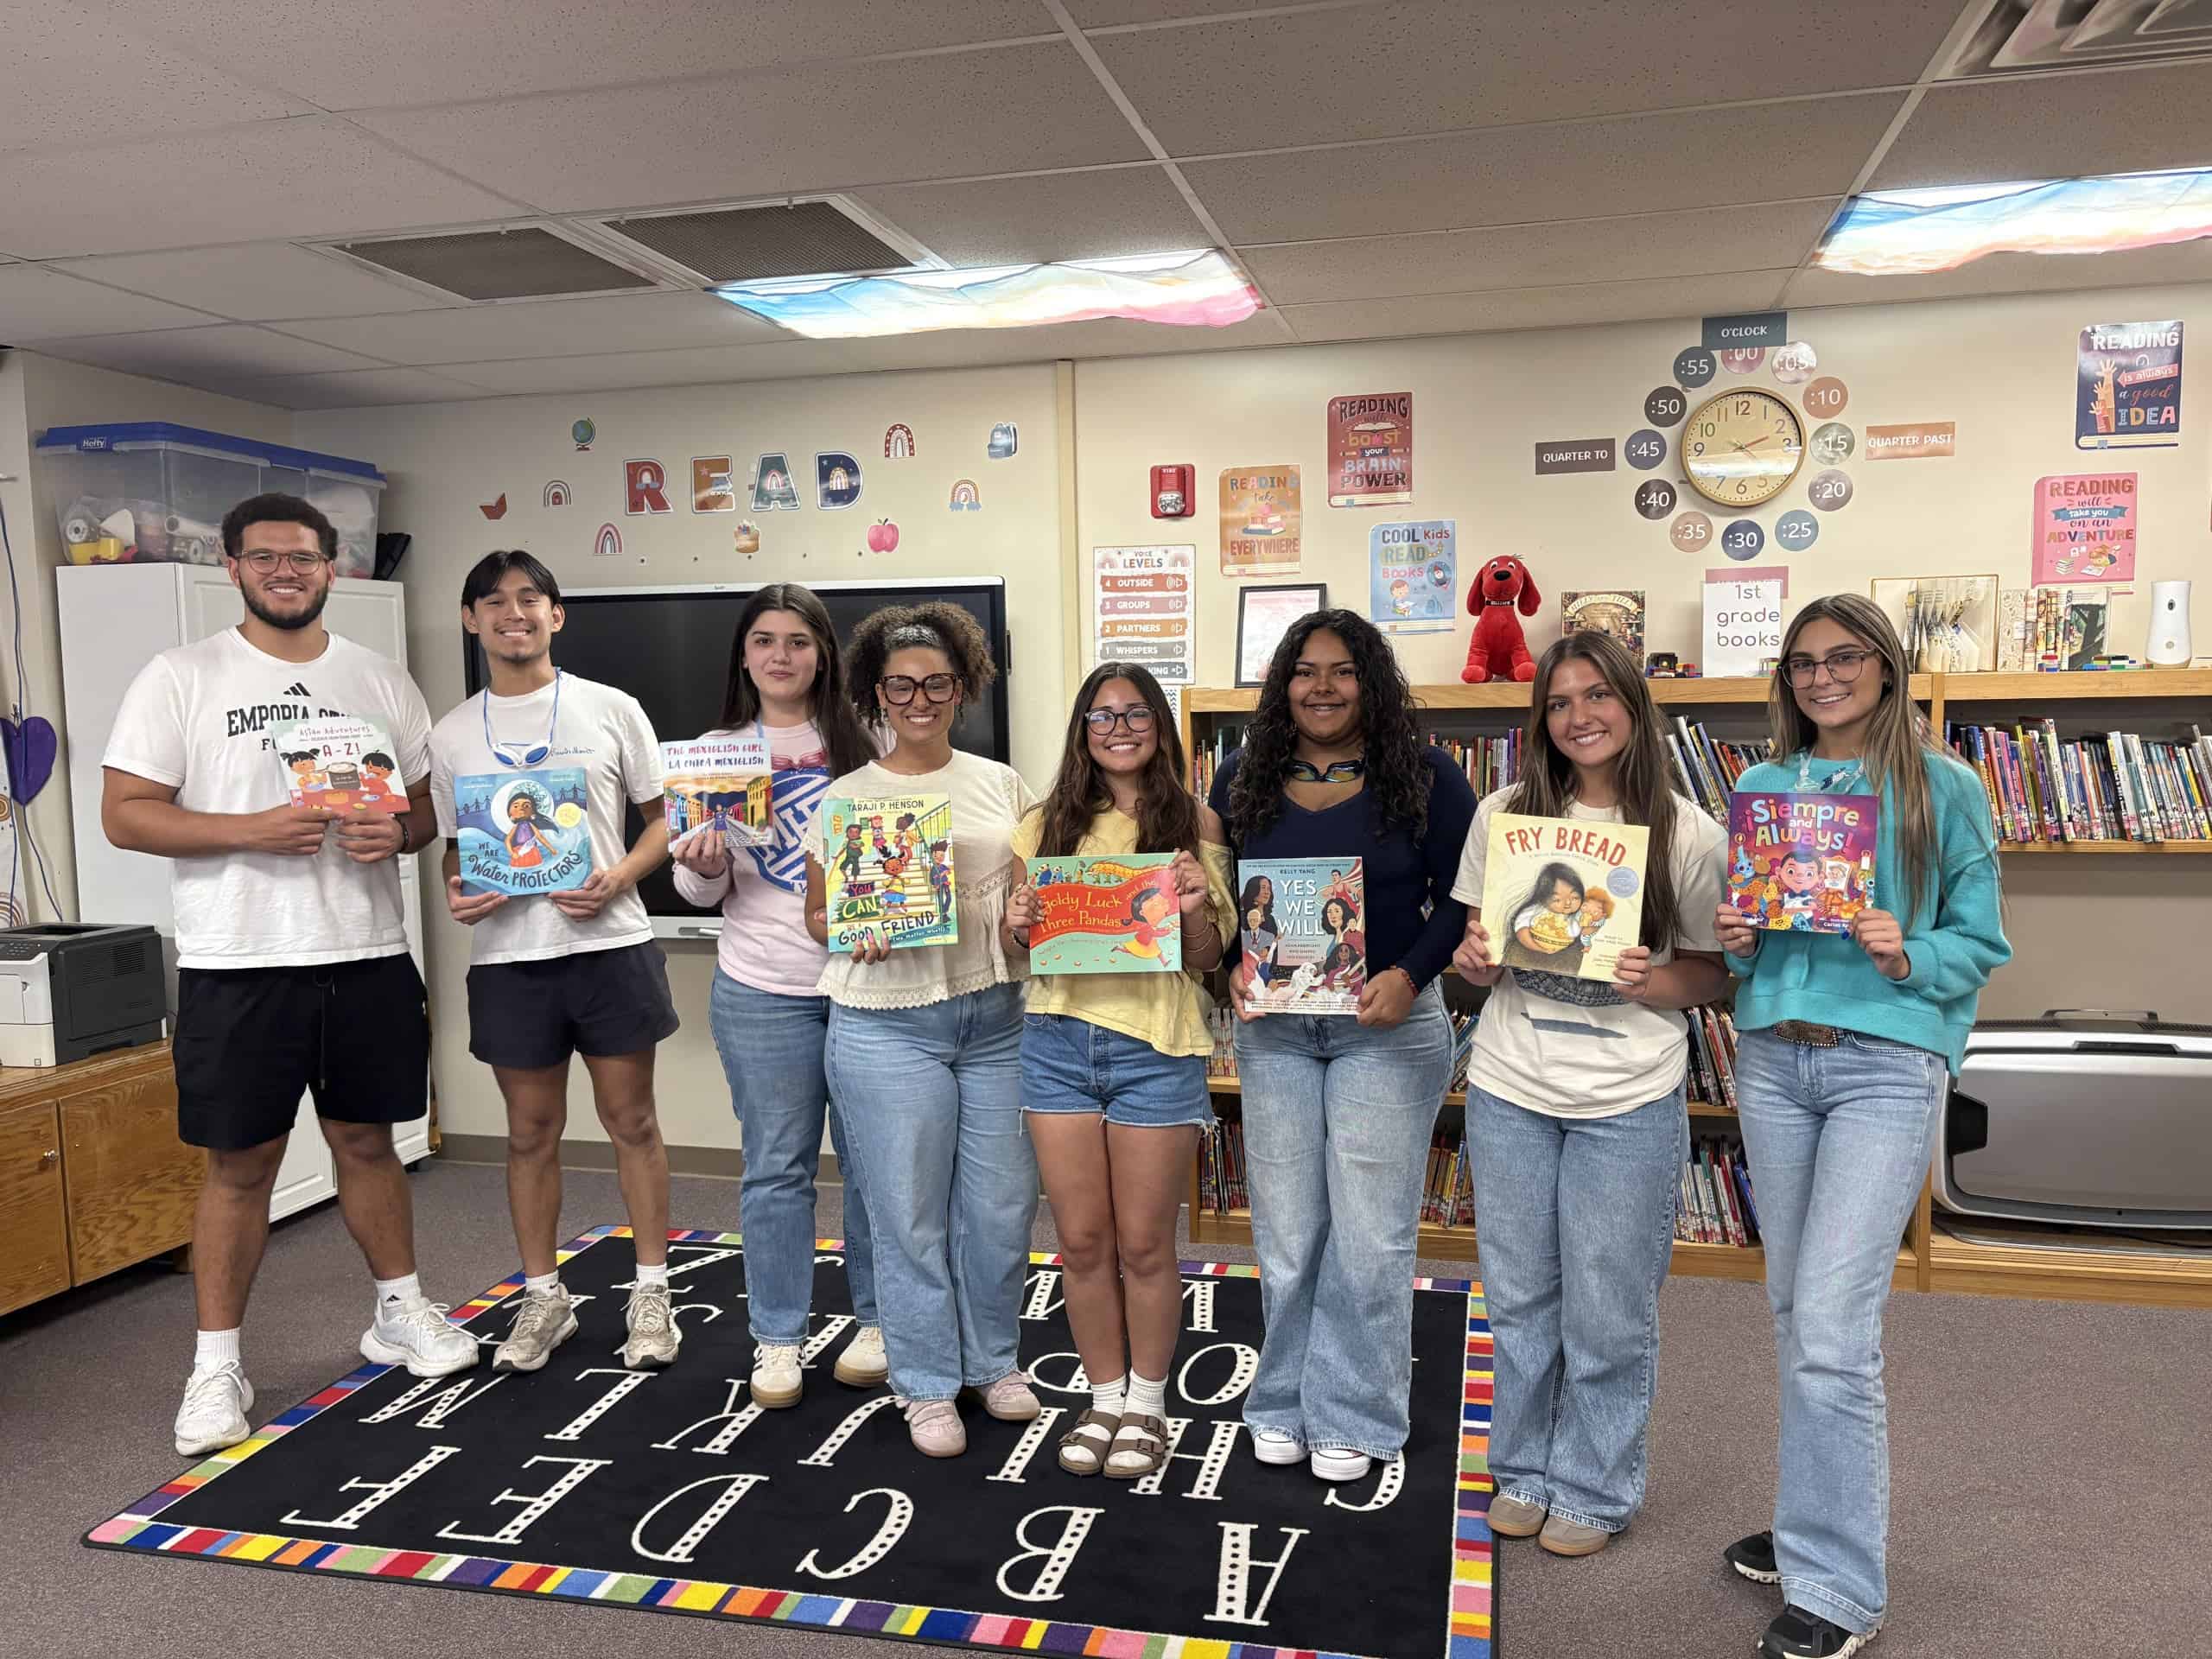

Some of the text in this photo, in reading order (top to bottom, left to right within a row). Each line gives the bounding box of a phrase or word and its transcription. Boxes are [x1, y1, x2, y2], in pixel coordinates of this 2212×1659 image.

[1721, 326, 1768, 338] O'CLOCK
[2092, 332, 2178, 350] READING
[1681, 359, 1709, 375] :55
[1810, 388, 1840, 405] :10
[1339, 397, 1408, 423] READING
[1651, 399, 1681, 415] :50
[1717, 407, 1728, 422] 11
[1735, 400, 1751, 416] 12
[2118, 406, 2176, 426] IDEA
[1700, 423, 1716, 437] 10
[1775, 418, 1786, 434] 2
[1631, 442, 1660, 456] :45
[1694, 442, 1705, 456] 9
[1818, 435, 1847, 450] :15
[1868, 434, 1953, 448] QUARTER PAST
[1364, 448, 1384, 457] your
[1542, 449, 1608, 463] QUARTER TO
[1344, 457, 1402, 474] BRAIN
[622, 451, 863, 516] READ
[1230, 474, 1300, 491] READING
[1340, 472, 1408, 489] POWER
[1736, 480, 1747, 495] 6
[2050, 479, 2133, 498] READING
[1815, 482, 1846, 499] :20
[1642, 491, 1670, 507] :40
[2091, 509, 2109, 518] you
[1382, 529, 1421, 543] COOL
[1677, 524, 1707, 539] :35
[1783, 523, 1812, 538] :25
[2046, 529, 2133, 543] ADVENTURE
[1230, 537, 1300, 556] EVERYWHERE
[1728, 531, 1758, 548] :30
[1383, 546, 1426, 563] READ
[1123, 558, 1163, 569] LEVELS
[1117, 578, 1154, 588] OUTSIDE
[1735, 584, 1762, 600] 1st
[1116, 600, 1151, 610] GROUPS
[1717, 607, 1780, 627] grade
[1116, 623, 1161, 633] PARTNERS
[1717, 631, 1780, 647] books
[1116, 645, 1159, 655] WHISPERS
[322, 745, 333, 757] A
[669, 760, 681, 769] LA
[847, 804, 877, 813] TARAJI
[889, 799, 925, 810] HENSON
[1789, 818, 1813, 829] and
[478, 842, 490, 851] WE
[484, 849, 499, 857] ARE
[1505, 826, 1543, 856] FRY
[1555, 826, 1627, 867] BREAD
[468, 849, 583, 888] Water PROTECTORS
[1280, 880, 1318, 896] YES
[842, 895, 878, 918] CAN
[1084, 891, 1123, 908] Luck
[1285, 899, 1316, 916] WE
[880, 911, 934, 934] FRIEND
[1039, 910, 1122, 934] Three Pandas
[1277, 918, 1325, 936] WILL
[543, 1368, 659, 1441] L
[279, 1446, 1311, 1626] A B C D E F
